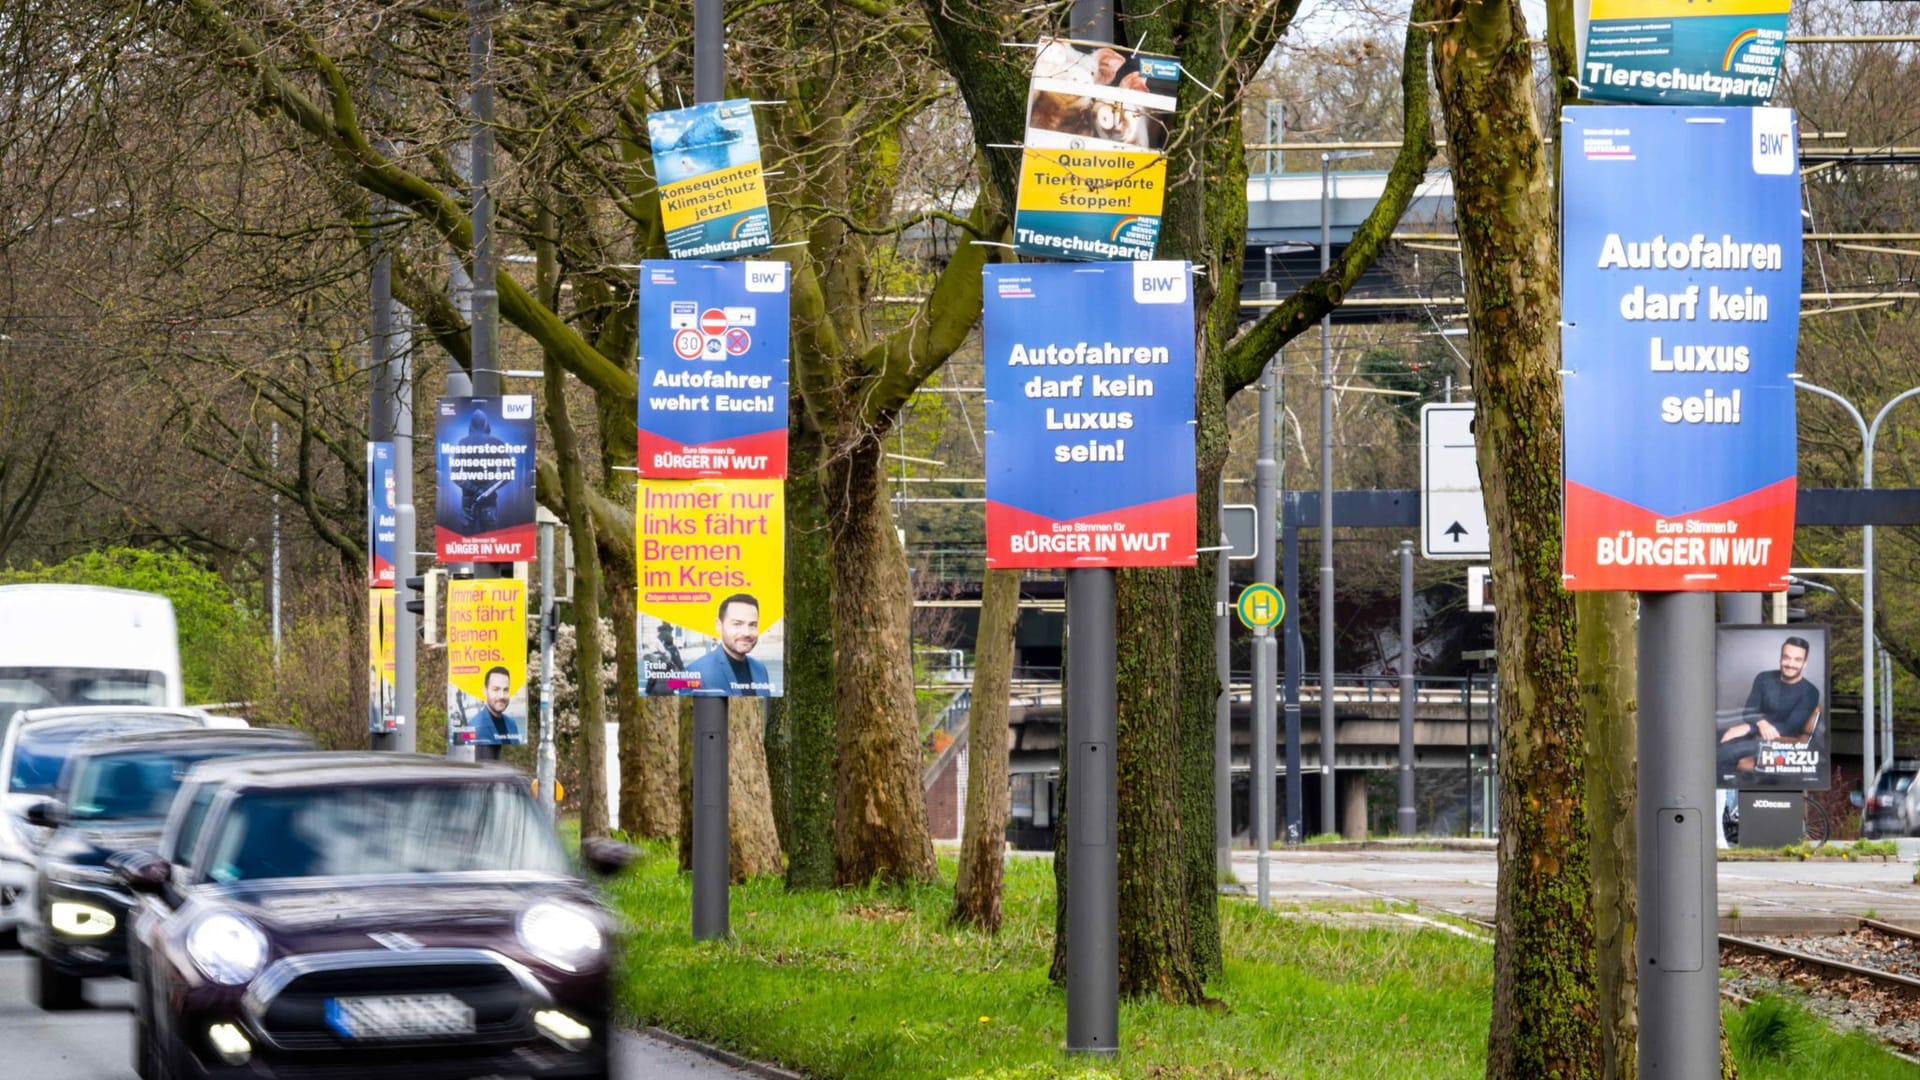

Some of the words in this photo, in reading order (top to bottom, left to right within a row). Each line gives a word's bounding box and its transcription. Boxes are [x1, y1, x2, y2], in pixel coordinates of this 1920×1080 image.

[1586, 62, 1774, 99] Tierschutzpartei
[1760, 133, 1785, 156] BIW
[1058, 153, 1136, 170] Qualvolle
[660, 167, 759, 200] Konsequenter
[1034, 172, 1154, 192] Tiertransporte
[667, 181, 757, 212] Klimaschutz
[1059, 195, 1131, 209] stoppen!
[695, 199, 732, 221] jetzt!
[669, 234, 770, 259] Tierschutzpartei
[1017, 228, 1154, 261] Tierschutzpartei
[1597, 233, 1782, 270] Autofahren
[752, 273, 775, 283] BIW
[1142, 277, 1173, 292] BIW
[1620, 285, 1700, 321] darf
[1709, 286, 1768, 321] kein
[681, 336, 698, 351] 30
[1008, 342, 1169, 366] Autofahren
[1650, 337, 1750, 372] Luxus
[652, 369, 772, 389] Autofahrer
[1024, 375, 1084, 398] darf
[1092, 374, 1154, 397] kein
[649, 394, 709, 411] wehrt
[716, 394, 775, 412] Euch!
[1661, 388, 1741, 424] sein!
[1046, 407, 1134, 430] Luxus
[441, 443, 527, 454] Messerstecher
[1054, 439, 1125, 462] sein!
[449, 456, 516, 469] konsequent
[654, 452, 710, 469] BÜRGER
[713, 455, 728, 469] IN
[731, 455, 769, 470] WUT
[450, 470, 515, 480] ausweisen!
[644, 487, 722, 509] Immer
[730, 492, 774, 509] nur
[643, 513, 697, 535] links
[704, 513, 768, 535] fährt
[1052, 522, 1073, 532] Eure
[1074, 522, 1112, 532] Stimmen
[1113, 521, 1126, 532] für
[1656, 519, 1683, 534] Eure
[1685, 519, 1726, 534] Stimmen
[445, 541, 479, 554] BÜRGER
[481, 543, 492, 554] IN
[494, 543, 521, 554] WUT
[643, 539, 741, 561] Bremen
[1010, 529, 1090, 553] BÜRGER
[1095, 533, 1117, 552] IN
[1120, 532, 1170, 552] WUT
[1597, 530, 1705, 566] BÜRGER
[1709, 537, 1728, 566] IN
[1732, 537, 1772, 566] WUT
[643, 565, 671, 587] im
[679, 565, 751, 587] Kreis.
[492, 589, 520, 602] nur
[477, 605, 515, 622] fährt
[1252, 595, 1270, 619] H
[450, 626, 498, 642] Bremen
[465, 645, 505, 662] Kreis.
[644, 660, 667, 670] Freie
[644, 670, 701, 679] Demokraten
